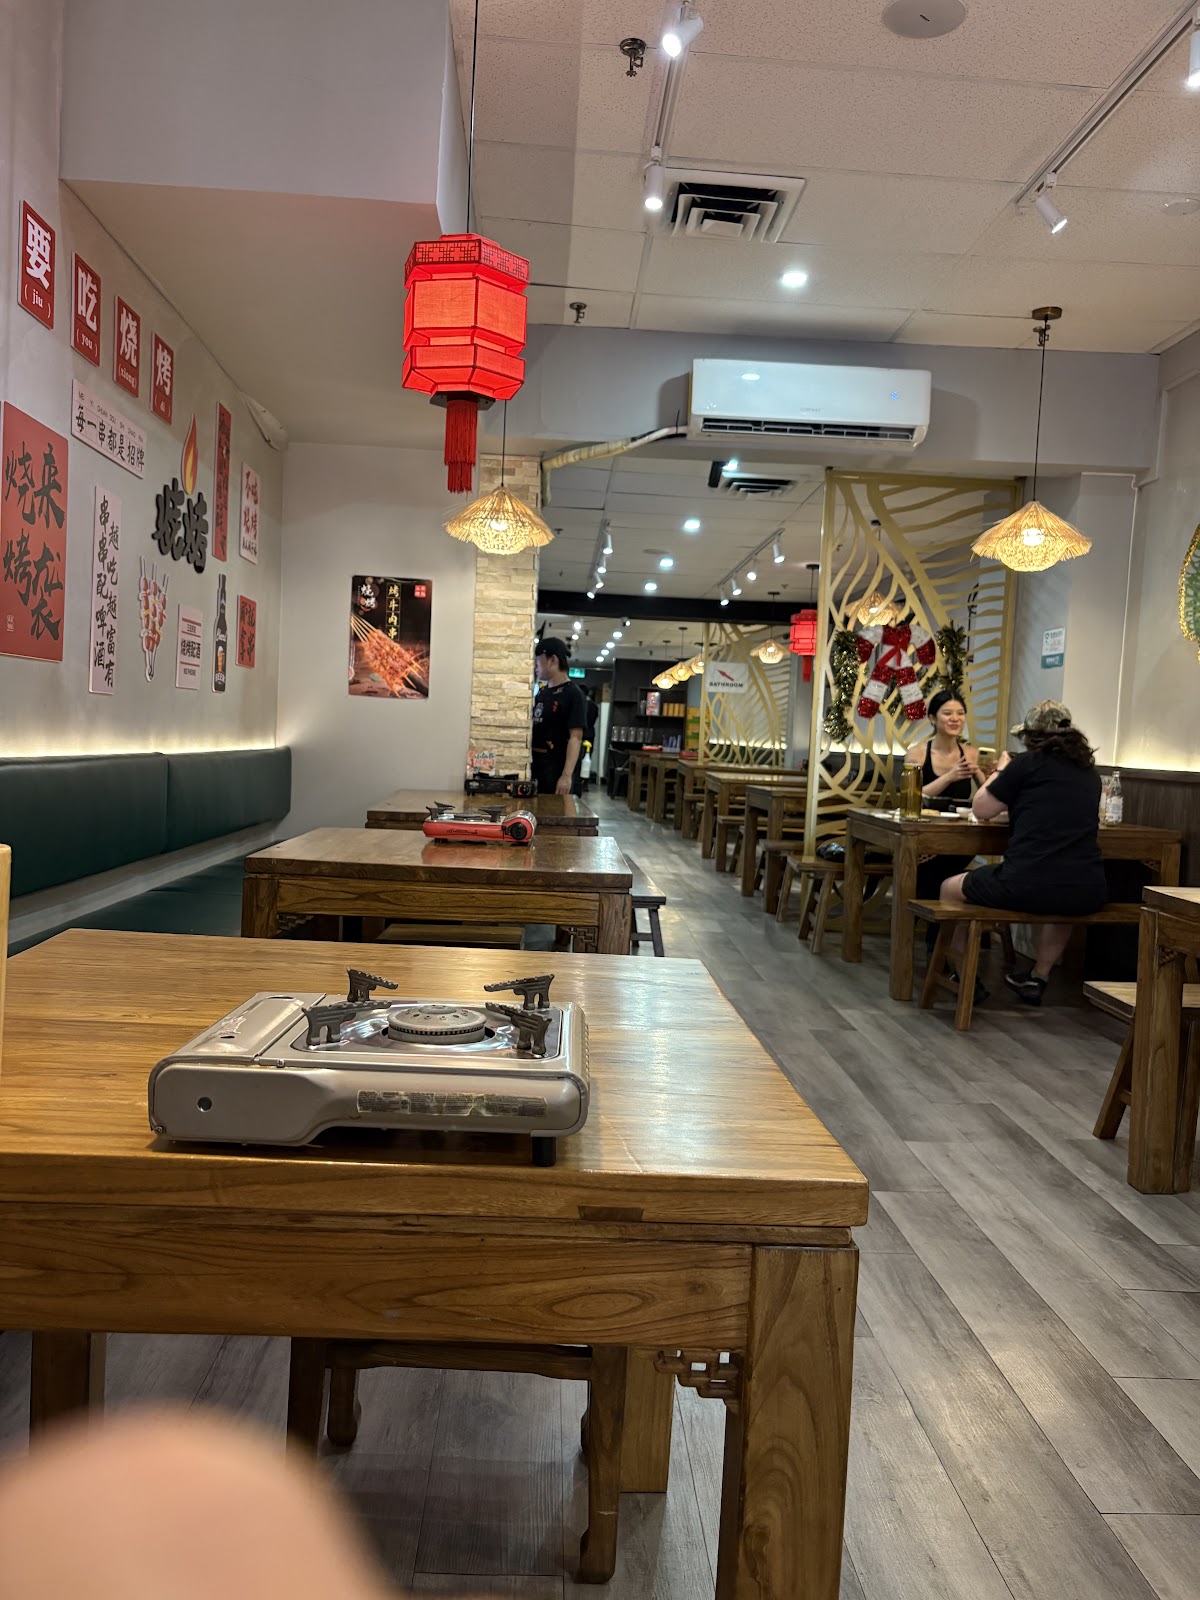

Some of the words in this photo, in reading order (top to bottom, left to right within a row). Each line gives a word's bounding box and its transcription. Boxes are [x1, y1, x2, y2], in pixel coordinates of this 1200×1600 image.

[26, 213, 51, 290] 要
[77, 266, 98, 332] 吃
[119, 306, 138, 368] 烧
[156, 343, 172, 397] 烤
[76, 404, 145, 472] 每一串都是招牌
[3, 441, 36, 607] 烧烤
[151, 477, 209, 574] 烧烤
[93, 495, 109, 669] 串串配啤酒
[104, 520, 120, 688] 越吃越富有
[360, 584, 376, 609] 烧烤
